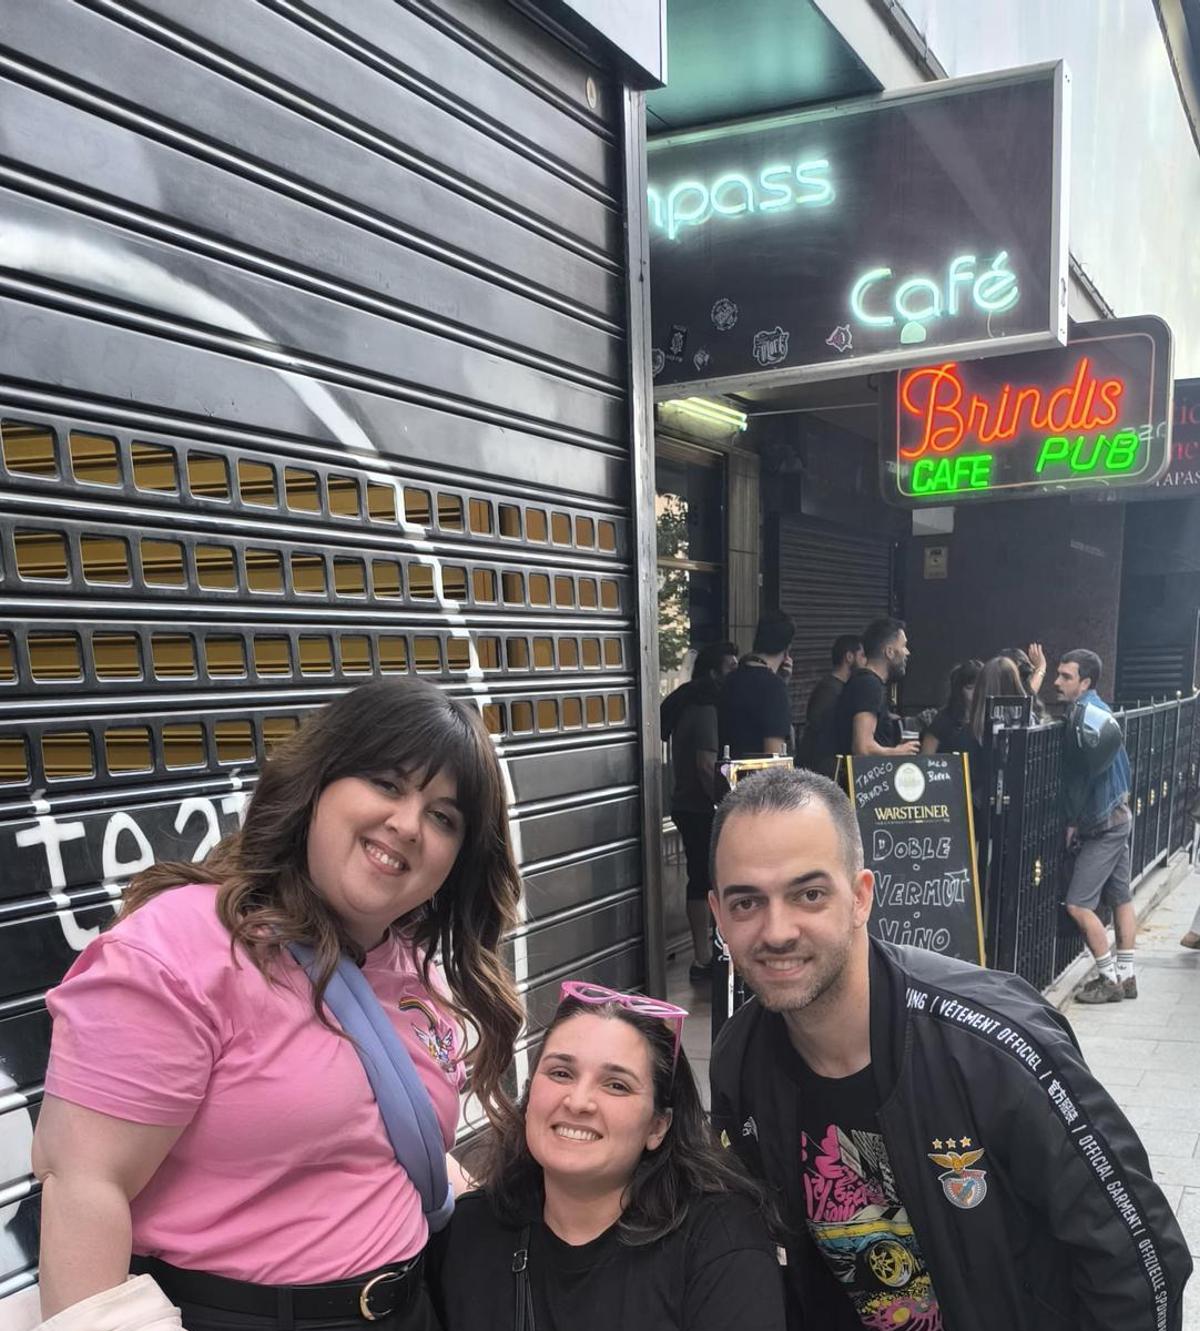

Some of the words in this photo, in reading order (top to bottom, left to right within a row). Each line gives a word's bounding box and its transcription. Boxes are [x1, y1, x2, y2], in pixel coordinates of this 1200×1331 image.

[851, 250, 1019, 325] Café
[899, 357, 1123, 458] Brindis
[912, 454, 992, 493] CAFE
[1035, 431, 1139, 473] PUB
[874, 805, 950, 820] WARSTEINER
[873, 829, 952, 861] DOBLE
[873, 868, 970, 907] VERMUT
[939, 999, 1001, 1035] VÊTEMENT
[996, 1027, 1043, 1072] OFFICIEL
[1078, 1134, 1115, 1182] OFFICIAL
[1106, 1180, 1143, 1231] GARMENT
[1138, 1238, 1166, 1292] OFFIZIELLE
